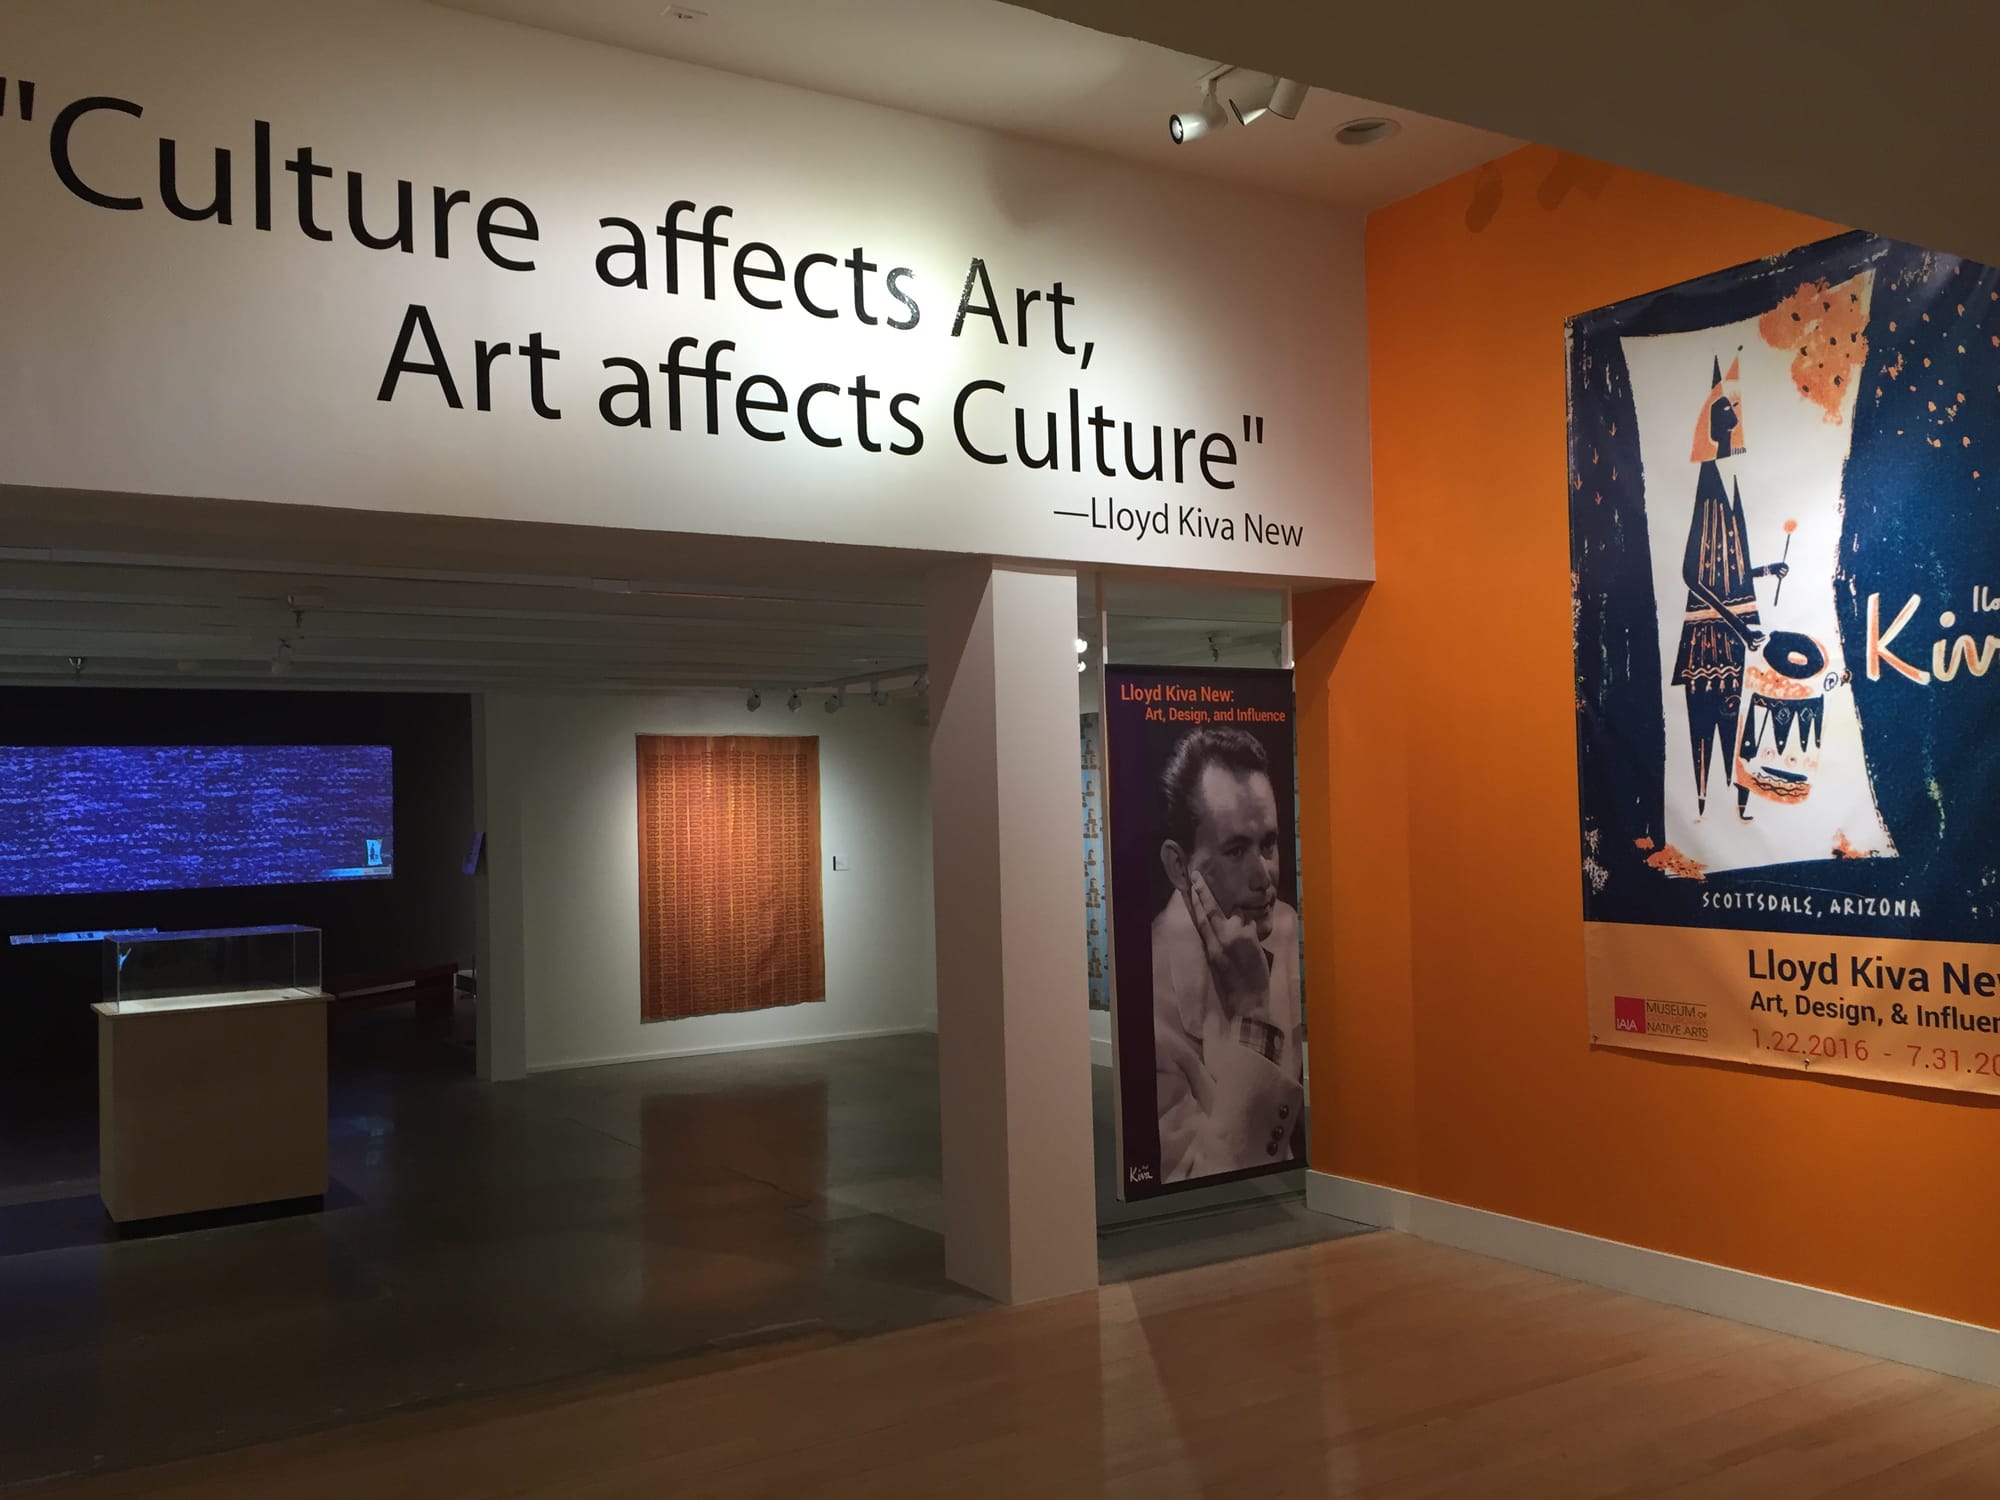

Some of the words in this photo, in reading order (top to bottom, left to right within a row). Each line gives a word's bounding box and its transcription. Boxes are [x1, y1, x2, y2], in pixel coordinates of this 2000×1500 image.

[595, 200, 921, 332] affects
[951, 257, 1095, 369] Art,
[377, 303, 562, 421] Art
[599, 337, 925, 456] affects
[952, 380, 1264, 490] Culture"
[1179, 505, 1235, 541] Kiva
[1244, 513, 1303, 547] New
[1120, 683, 1162, 705] Lloyd
[1165, 684, 1197, 702] Kiva
[1200, 686, 1235, 703] New:
[1145, 707, 1167, 723] Art,
[1169, 706, 1211, 724] Design,
[1213, 708, 1234, 721] and
[1237, 708, 1286, 722] Influence
[1702, 891, 1823, 918] SCOTTSDALE,
[1830, 897, 1921, 917] ARIZONA
[1748, 948, 1839, 991] Lloyd
[1850, 955, 1930, 993] Kiva
[1646, 1002, 1696, 1017] MUSEUM
[1750, 991, 1788, 1017] Art,
[1795, 994, 1883, 1027] Design,
[1891, 1003, 1908, 1025] &
[1616, 1018, 1638, 1032] IAIA
[1647, 1022, 1681, 1035] NATIVE
[1683, 1026, 1709, 1039] ARTS
[1752, 1028, 1869, 1062] 1.22.2016
